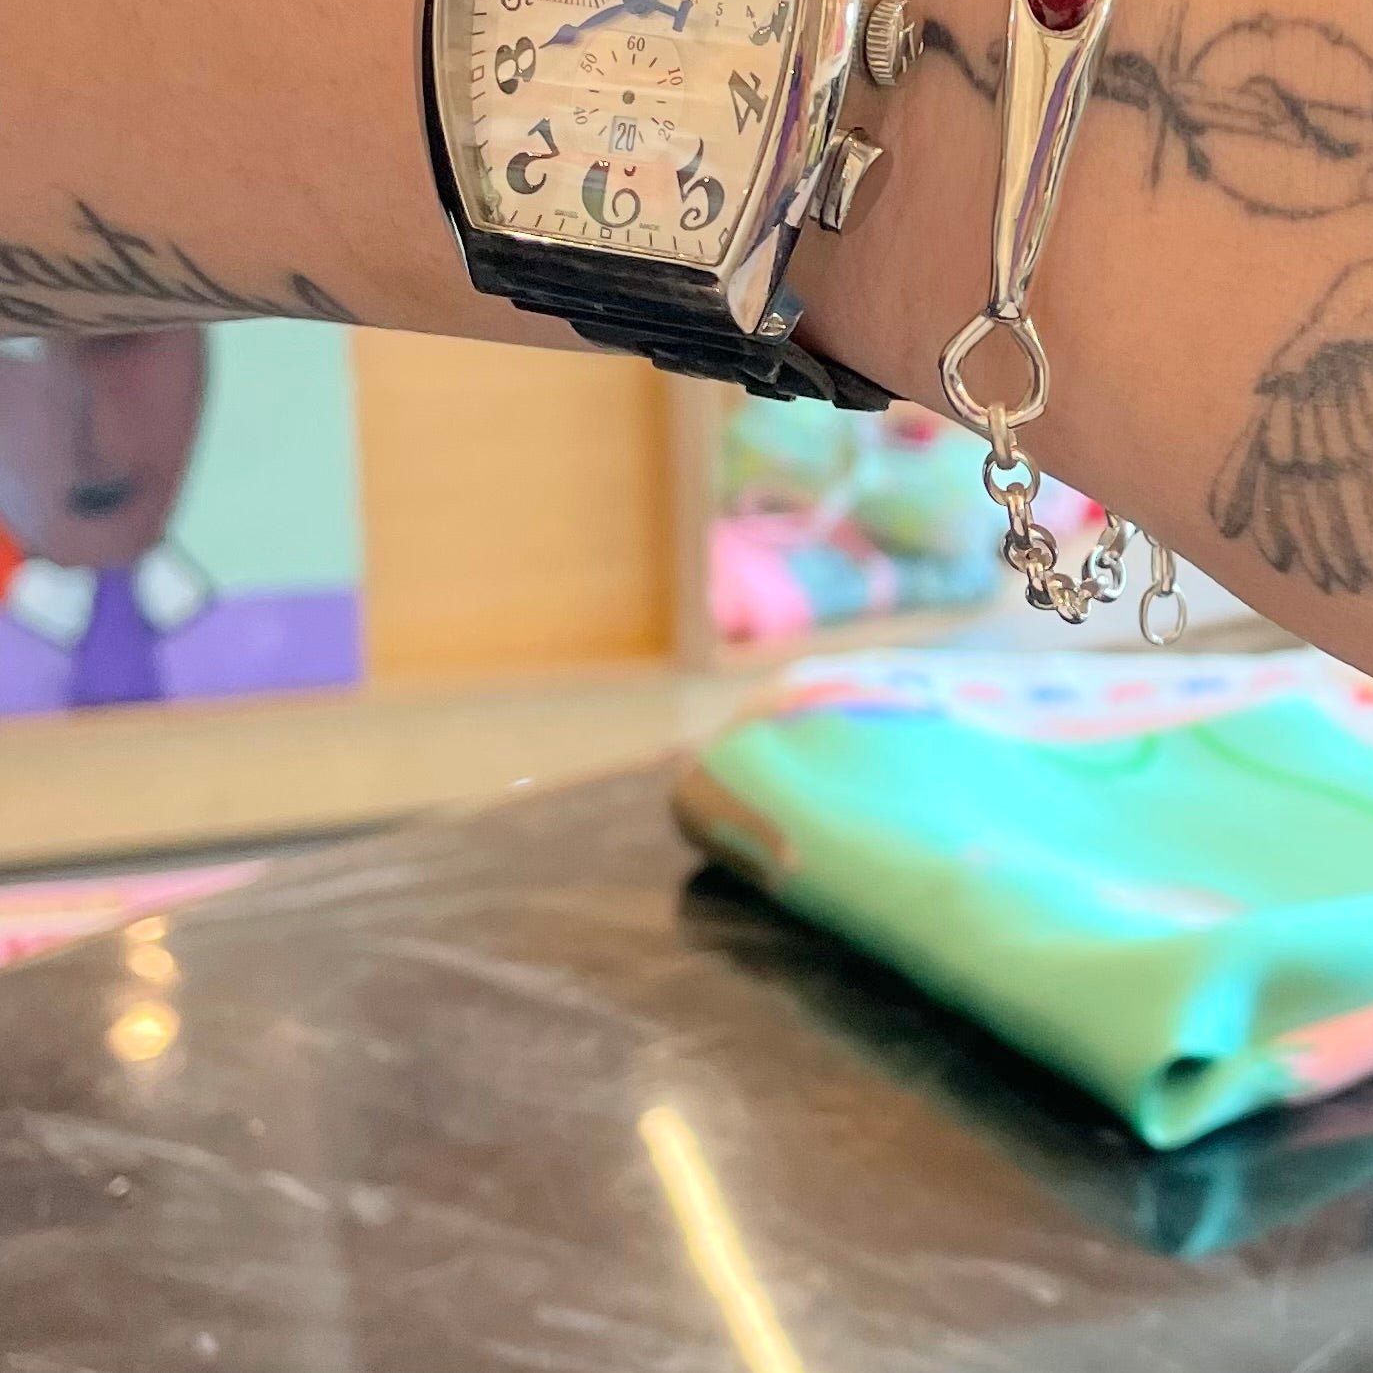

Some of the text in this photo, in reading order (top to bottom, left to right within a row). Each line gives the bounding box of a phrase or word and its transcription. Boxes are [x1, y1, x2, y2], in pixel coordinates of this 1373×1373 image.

[715, 2, 724, 17] 5
[626, 35, 646, 52] 60
[494, 36, 536, 95] 8
[580, 52, 598, 73] 50
[667, 66, 684, 86] 10
[727, 68, 770, 135] 4
[615, 122, 637, 152] 20
[657, 120, 676, 141] 20
[506, 117, 560, 195] 7
[581, 160, 641, 228] 6
[675, 137, 726, 231] 5
